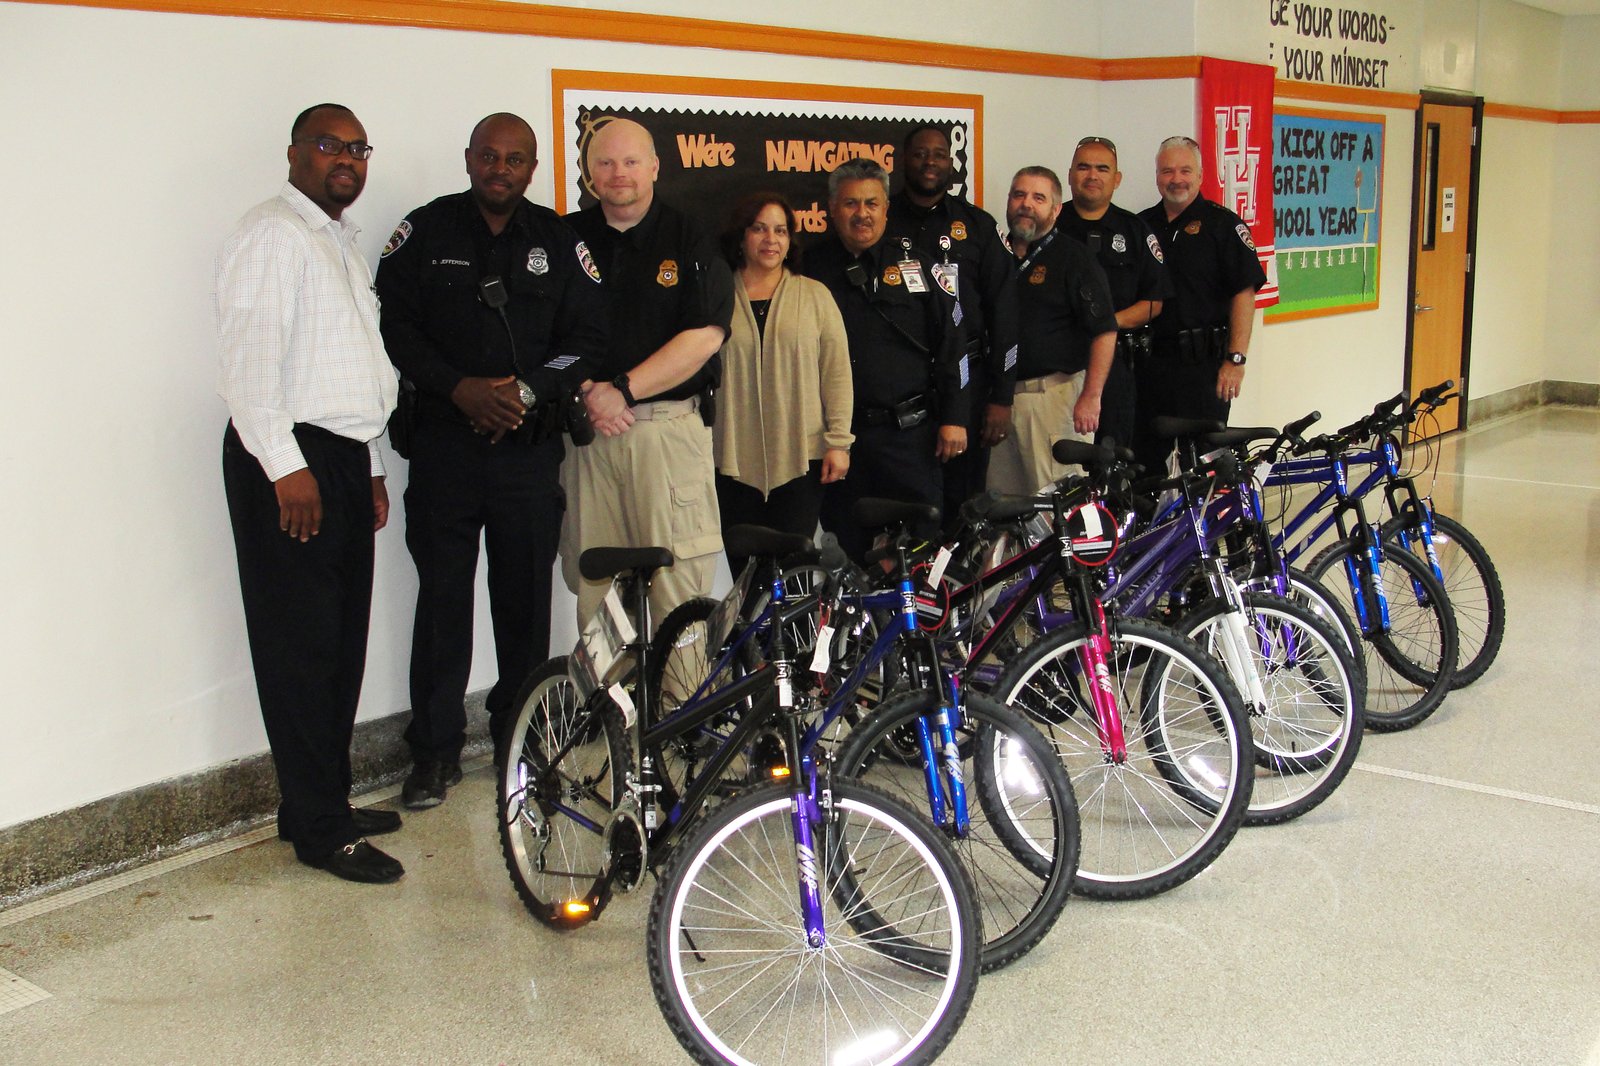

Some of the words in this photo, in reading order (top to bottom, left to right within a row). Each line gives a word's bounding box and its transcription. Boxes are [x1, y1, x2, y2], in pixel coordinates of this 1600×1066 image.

[1294, 3, 1332, 39] YOUR
[1284, 46, 1325, 82] YOUR
[1280, 127, 1325, 160] KICK
[1330, 131, 1357, 161] OFF
[1362, 133, 1373, 162] A
[1273, 164, 1329, 196] GREAT
[1273, 206, 1315, 238] HOOL
[1319, 206, 1358, 237] YEAR
